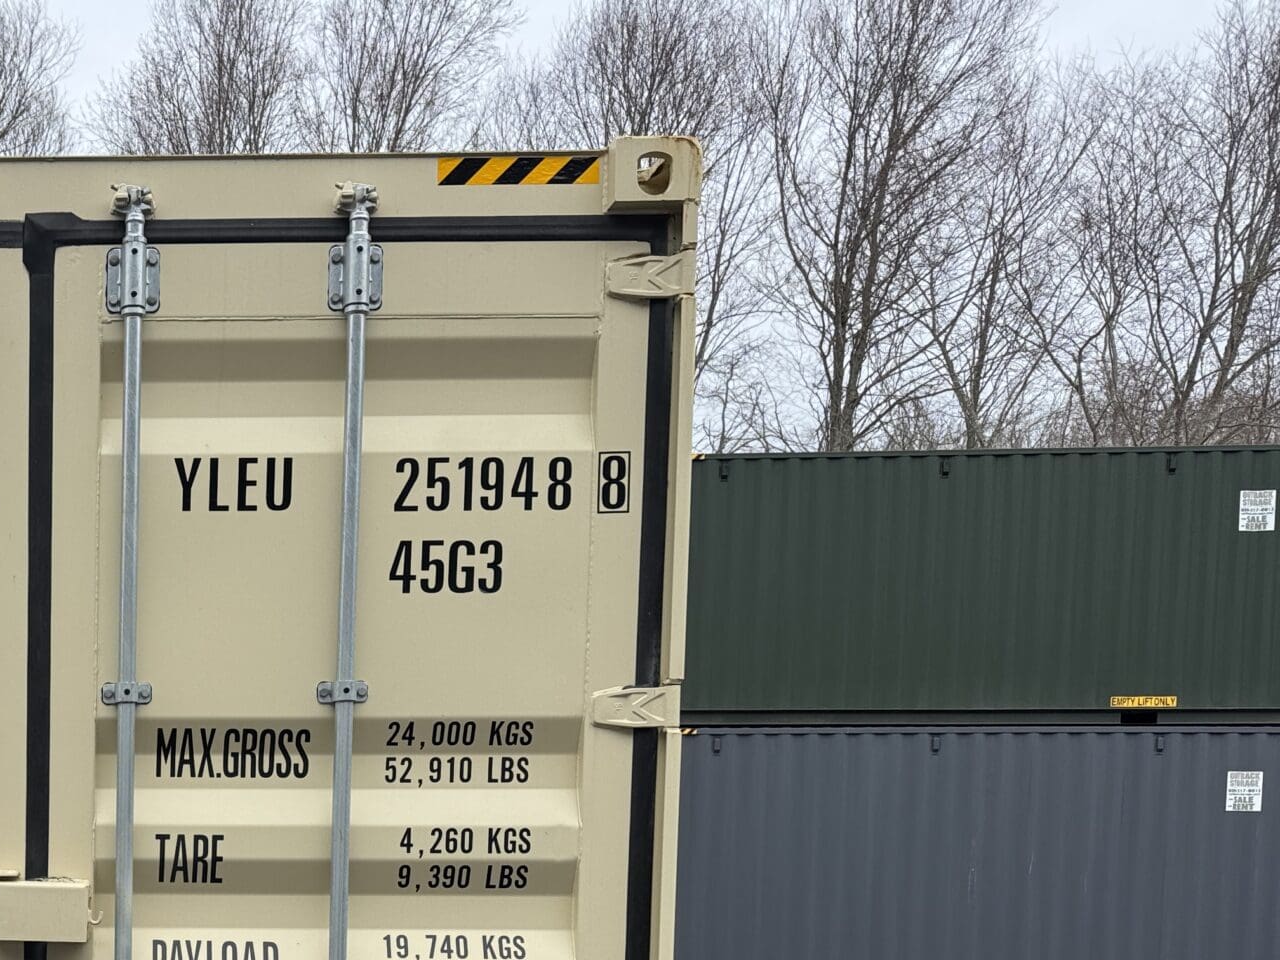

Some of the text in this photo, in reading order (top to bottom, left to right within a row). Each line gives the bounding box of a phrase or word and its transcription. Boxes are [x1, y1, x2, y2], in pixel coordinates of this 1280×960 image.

[174, 455, 628, 512] YLEU 251948 8
[388, 539, 504, 594] 45G3
[1112, 697, 1176, 706] EMPTY LIFT ONLY
[386, 720, 535, 750] 24,000 KGS
[155, 727, 311, 779] MAX.GROSS
[384, 756, 530, 788] 52,910 LBS
[399, 827, 532, 858] 4,260 KGS
[155, 834, 225, 884] TARE
[397, 864, 529, 892] 9,390 LBS
[481, 934, 527, 960] KGS
